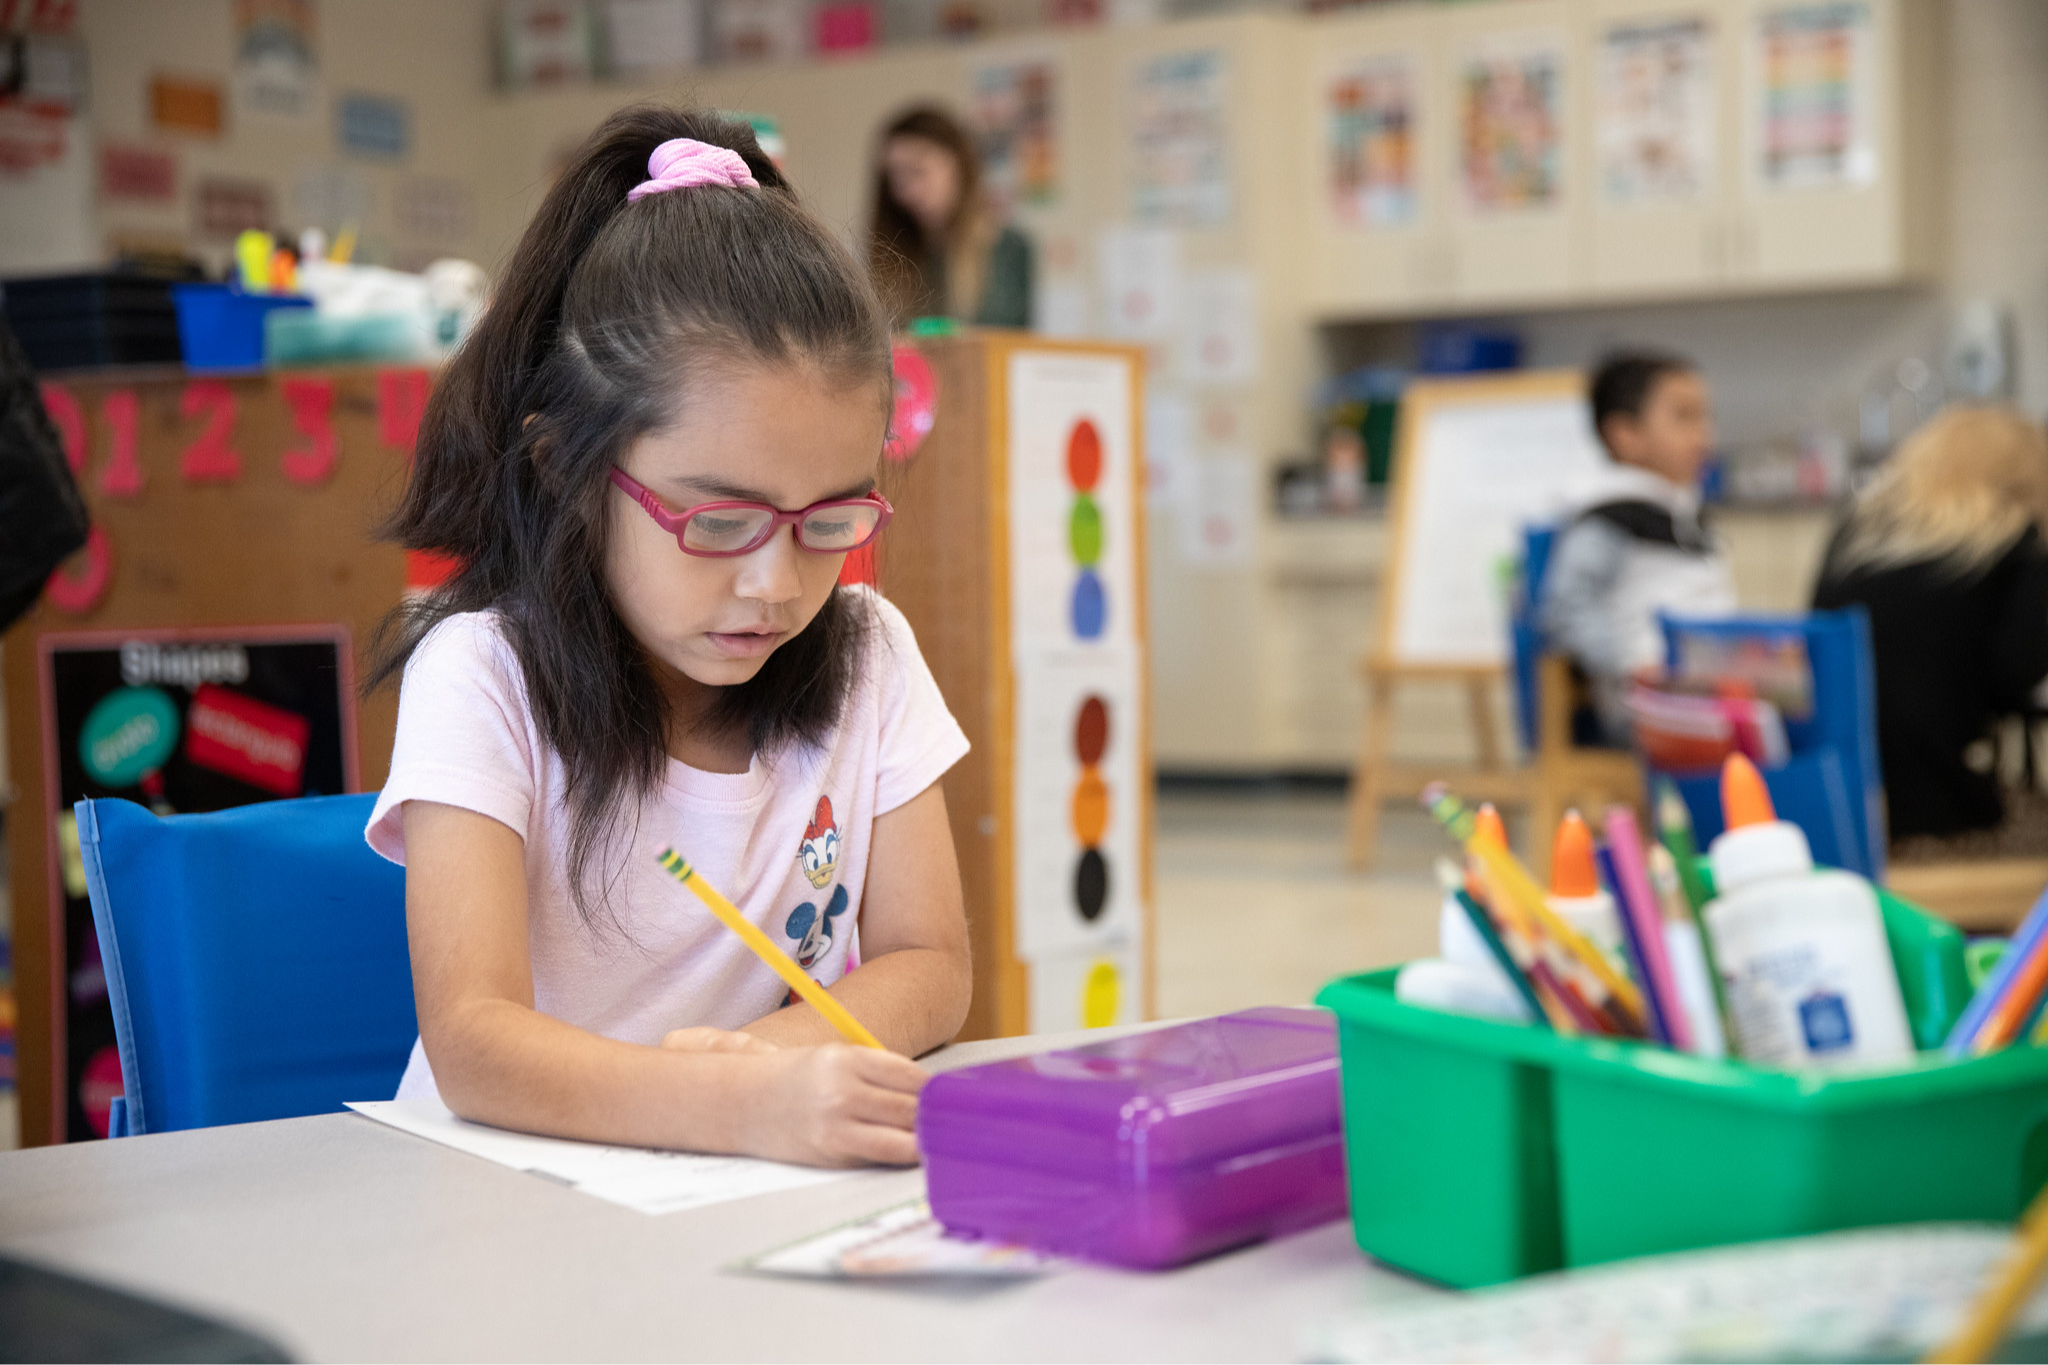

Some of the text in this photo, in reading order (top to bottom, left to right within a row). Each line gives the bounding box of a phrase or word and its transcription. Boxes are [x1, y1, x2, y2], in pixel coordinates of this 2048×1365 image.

[102, 389, 142, 496] 1
[183, 378, 241, 481] 2
[282, 379, 338, 484] 3
